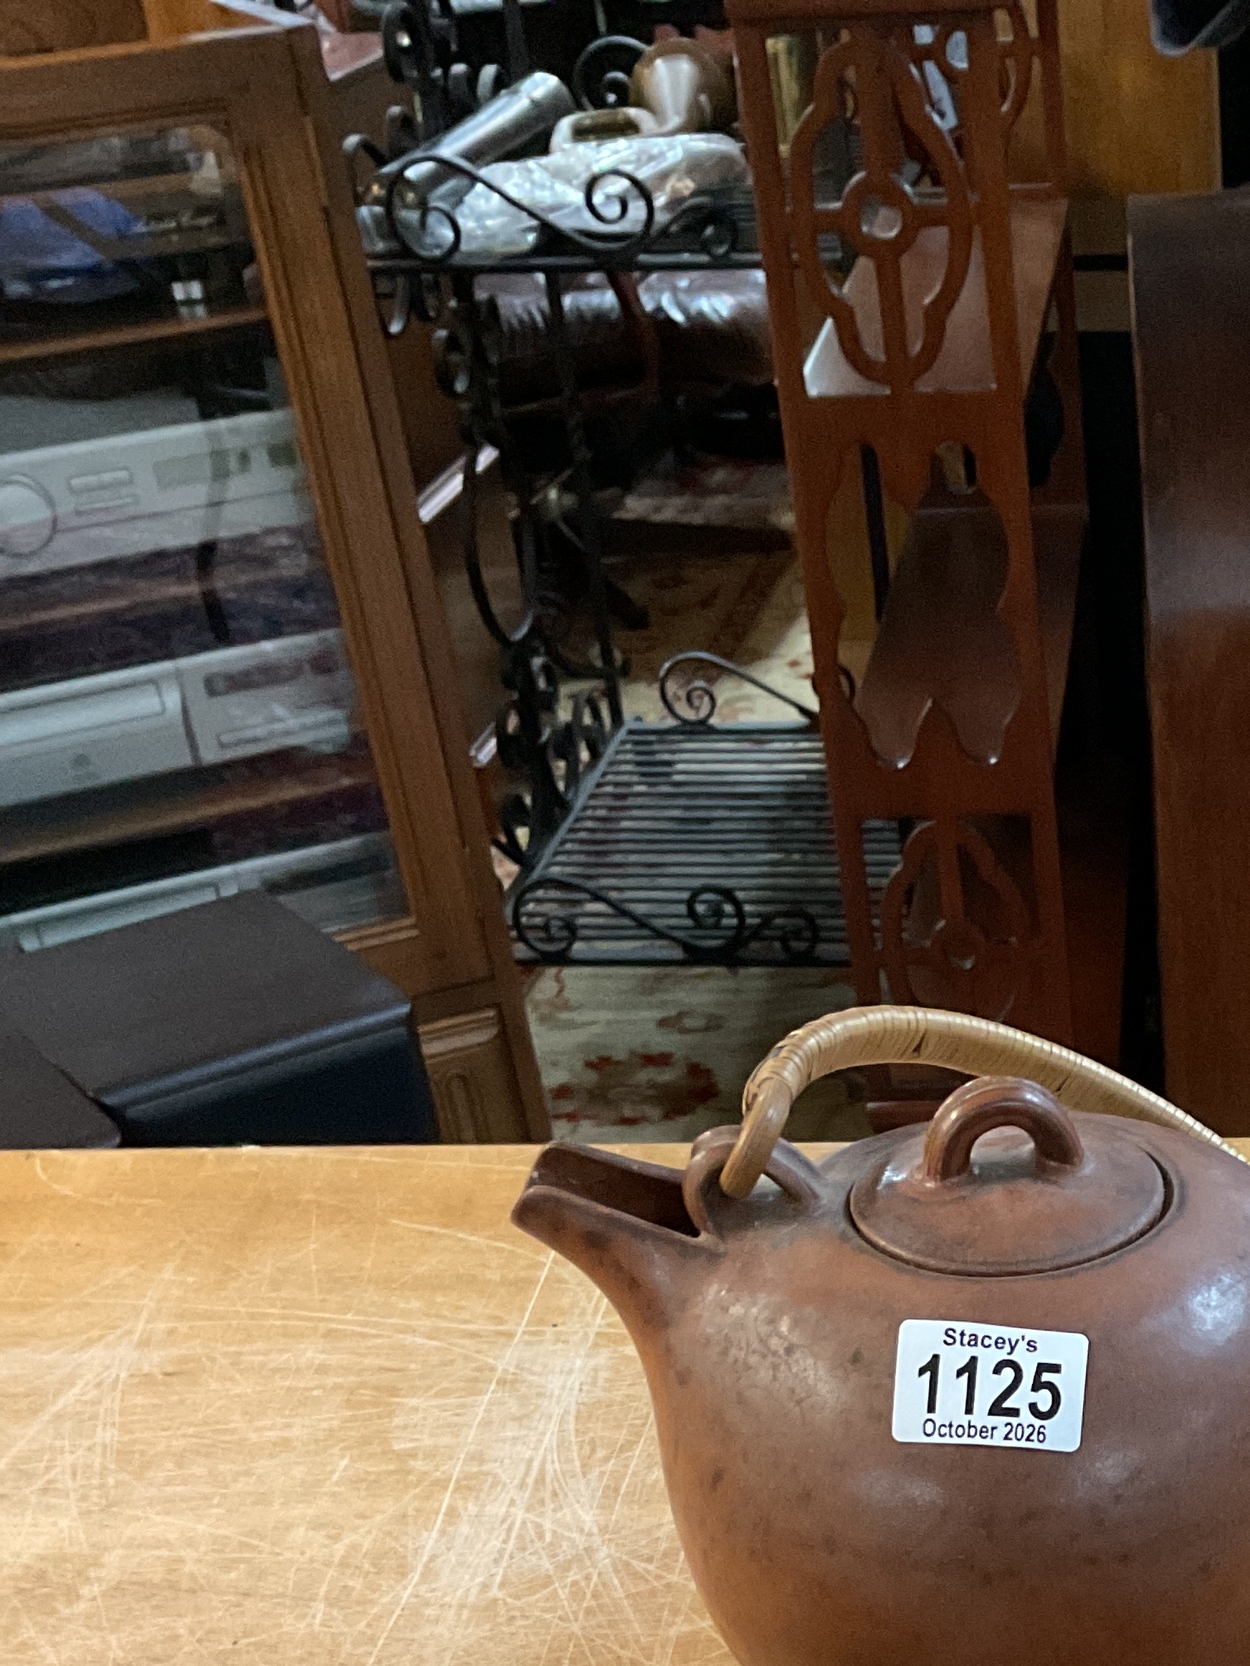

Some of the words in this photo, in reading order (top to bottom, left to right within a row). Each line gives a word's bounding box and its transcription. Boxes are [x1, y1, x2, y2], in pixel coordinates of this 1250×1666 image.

[942, 1327, 1038, 1355] Stacey's
[917, 1353, 1062, 1421] 1125
[922, 1418, 998, 1440] October
[1002, 1421, 1047, 1443] 2026
